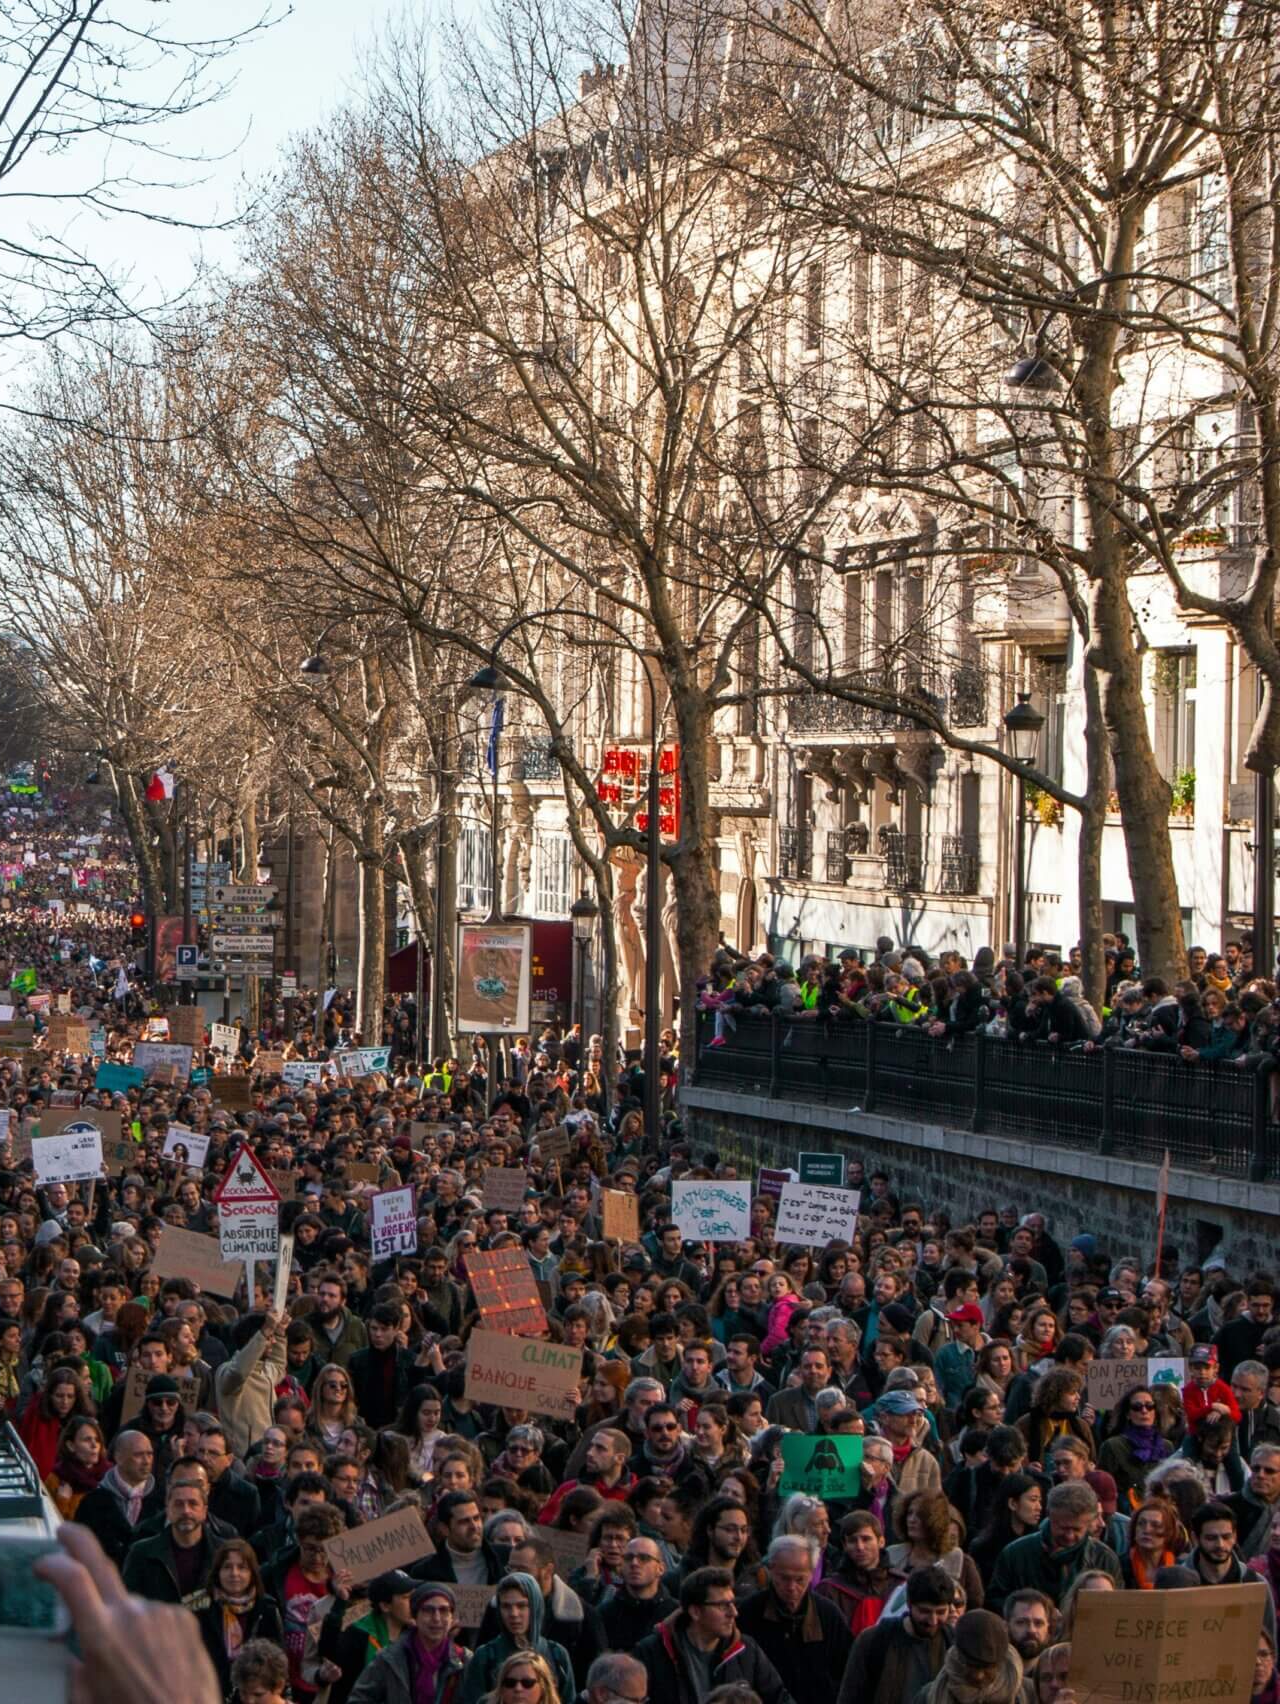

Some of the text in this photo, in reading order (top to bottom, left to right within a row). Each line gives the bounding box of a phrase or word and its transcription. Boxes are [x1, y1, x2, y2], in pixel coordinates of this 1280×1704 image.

[182, 950, 192, 962] P
[216, 1024, 238, 1036] RISE
[223, 1186, 270, 1195] ROCKWOOL
[222, 1241, 279, 1254] CLIMATIQUE
[374, 1236, 396, 1255] EST
[521, 1344, 581, 1369] CLIMAT
[471, 1364, 537, 1391] BANQUE
[1089, 1364, 1147, 1380] ON PERD
[1100, 1383, 1114, 1398] LA
[1114, 1618, 1226, 1640] ESPECE EN
[1103, 1651, 1184, 1668] VOIE DE
[1121, 1677, 1238, 1704] DISPARITION
